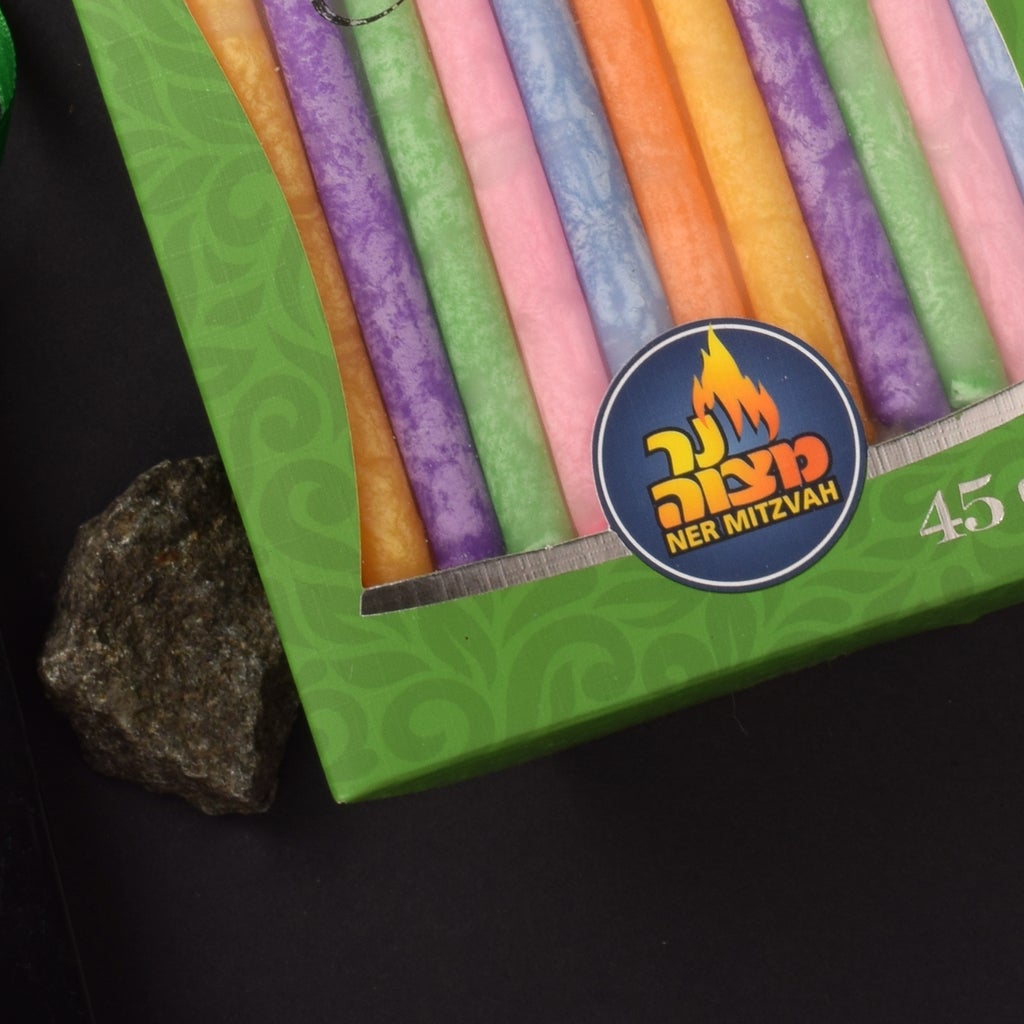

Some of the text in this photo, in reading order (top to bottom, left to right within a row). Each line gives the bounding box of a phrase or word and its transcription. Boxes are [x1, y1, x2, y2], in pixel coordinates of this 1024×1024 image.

[645, 414, 725, 477] נר
[651, 434, 830, 529] מצוה
[666, 481, 839, 554] NER MITZVAH
[919, 474, 1005, 545] 45
